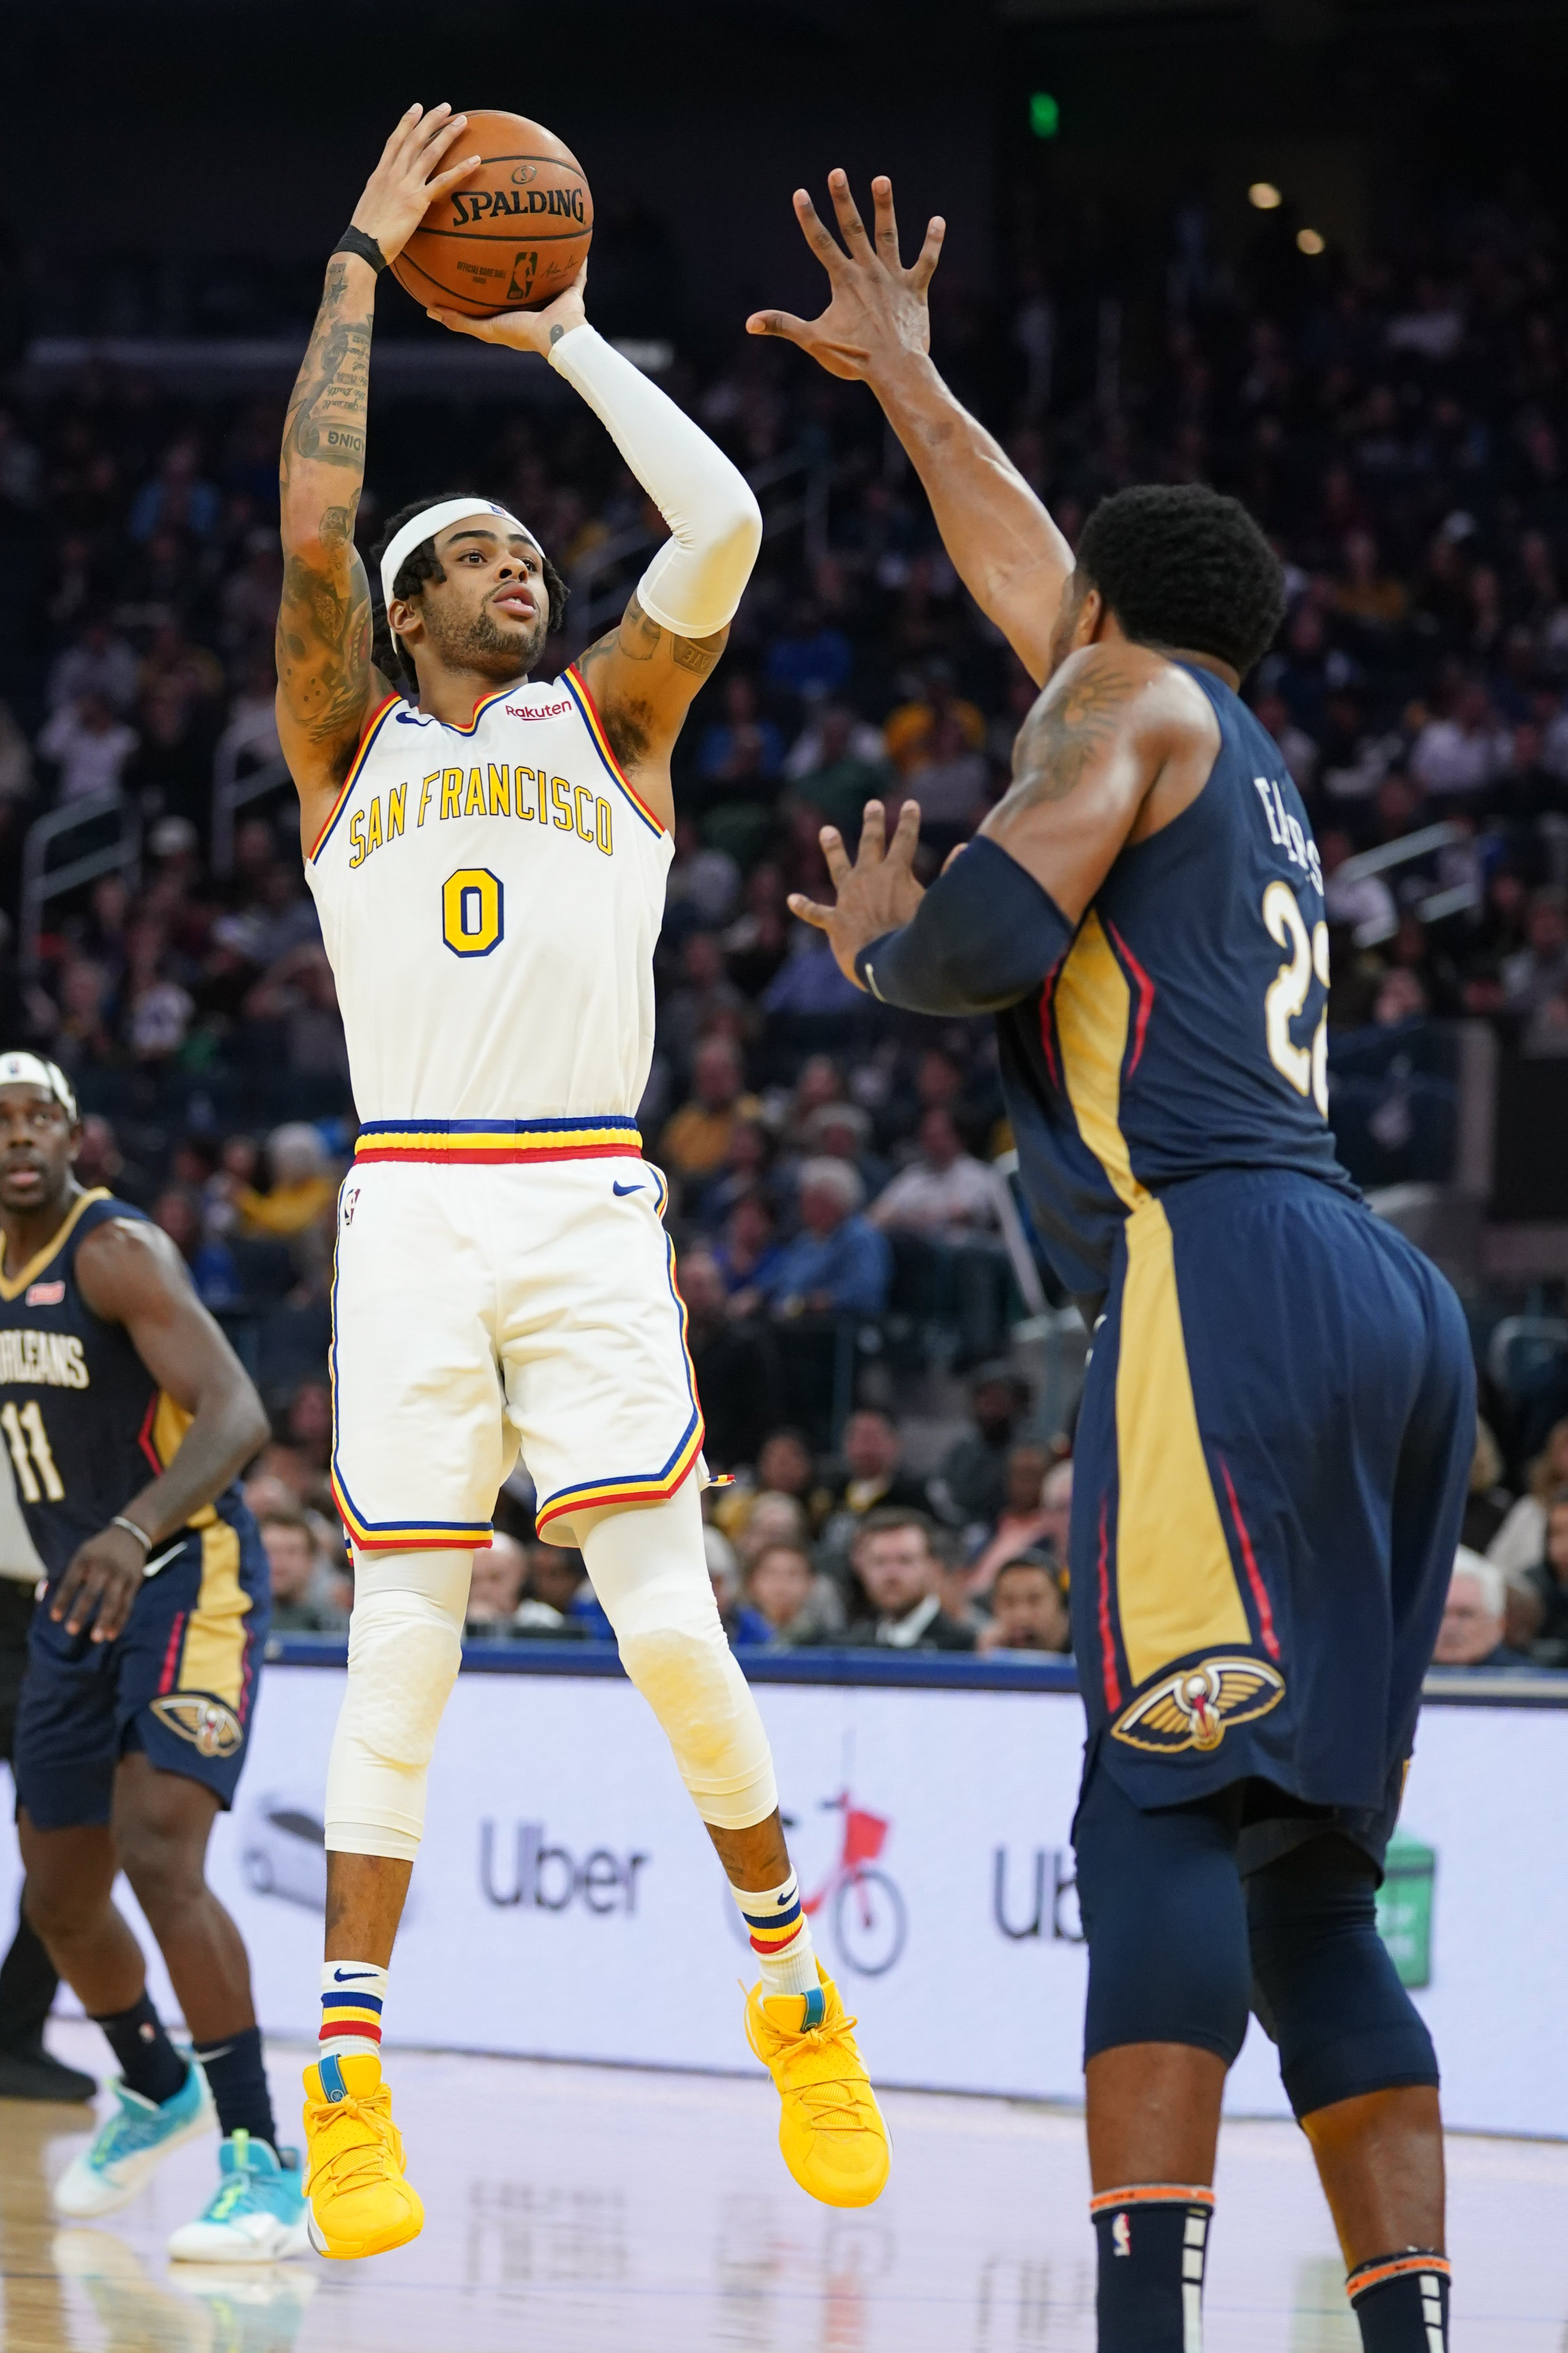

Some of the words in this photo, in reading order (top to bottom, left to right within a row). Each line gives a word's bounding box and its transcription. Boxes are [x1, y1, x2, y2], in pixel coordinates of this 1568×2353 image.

[451, 188, 584, 226] SPALDING
[505, 700, 573, 720] Rakuten
[349, 782, 407, 869] SAN
[417, 763, 613, 856] FRANCISCO
[442, 868, 505, 958] 0
[1, 1400, 66, 1504] 11
[479, 1817, 650, 1919] Uber
[992, 1846, 1086, 1943] Ub
